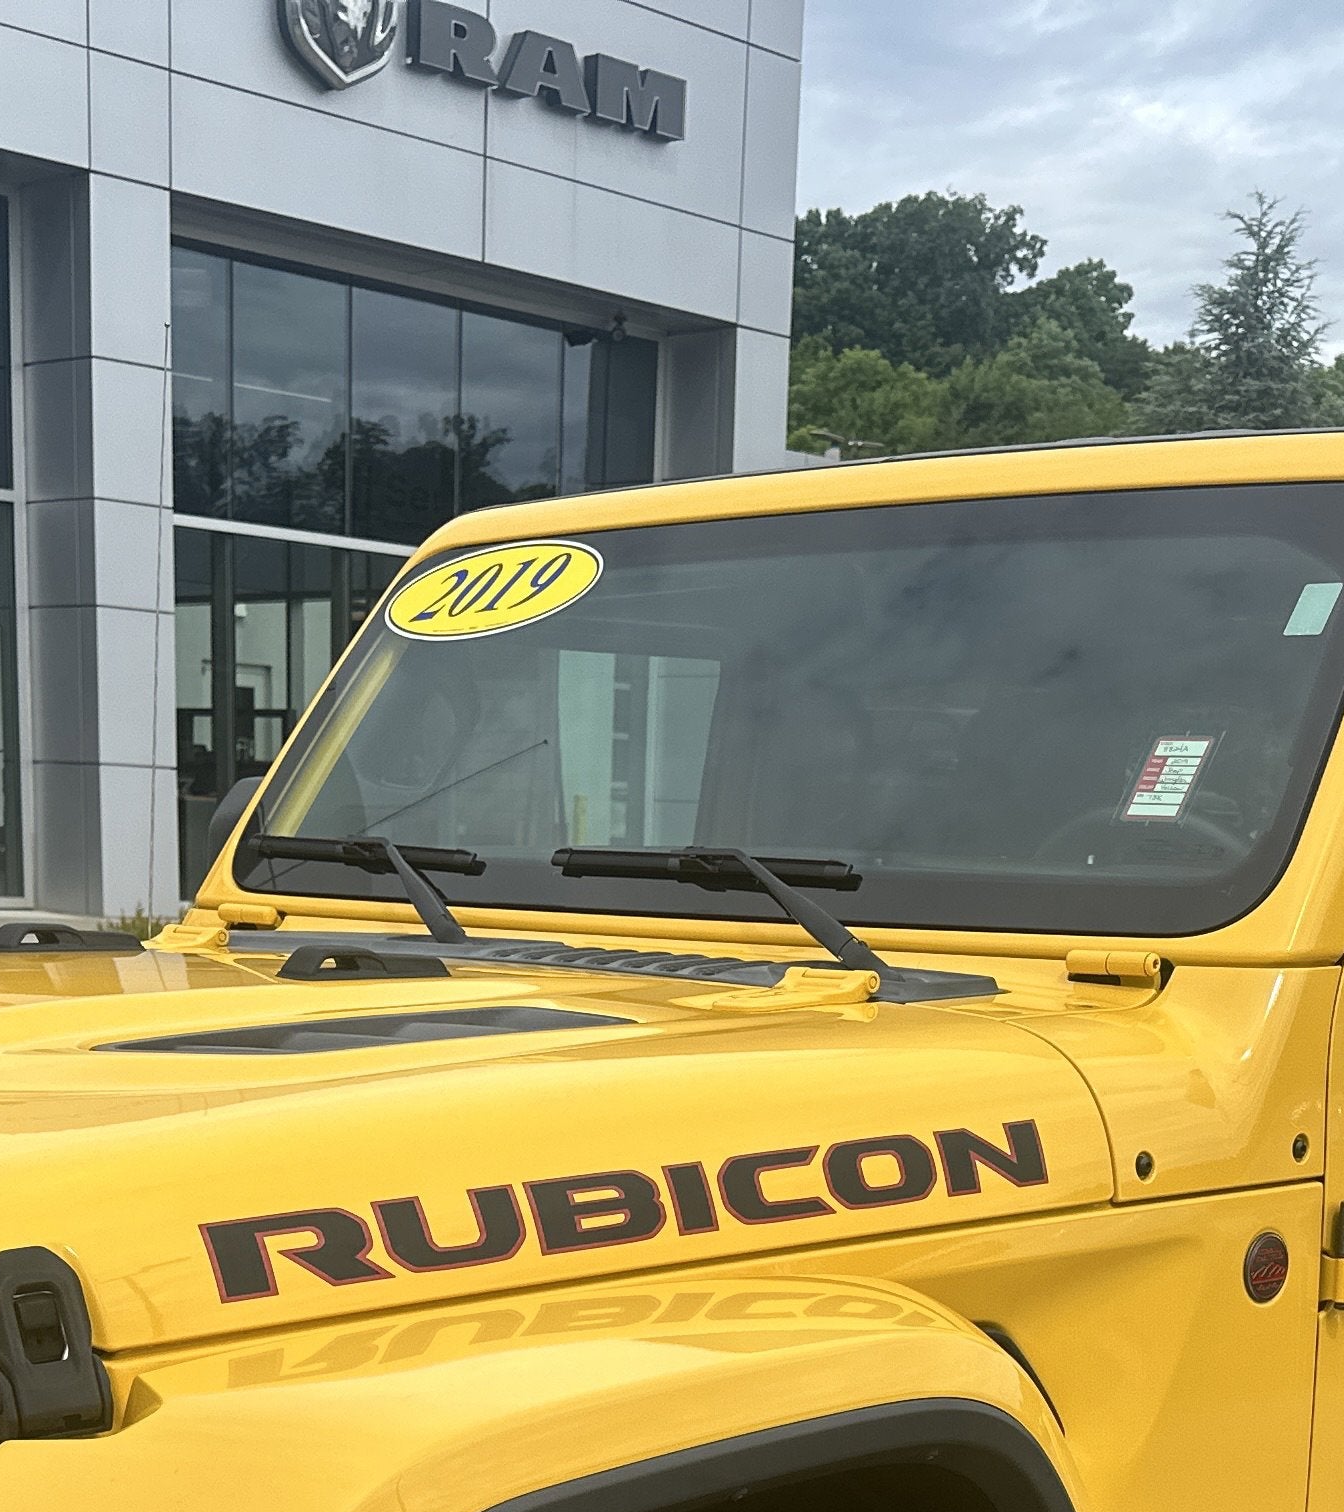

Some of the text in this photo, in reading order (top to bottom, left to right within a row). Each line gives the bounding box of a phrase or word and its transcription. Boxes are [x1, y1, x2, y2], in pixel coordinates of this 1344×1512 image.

[406, 0, 687, 141] RAM
[408, 553, 572, 622] 2019
[198, 1119, 1049, 1303] RUBICON
